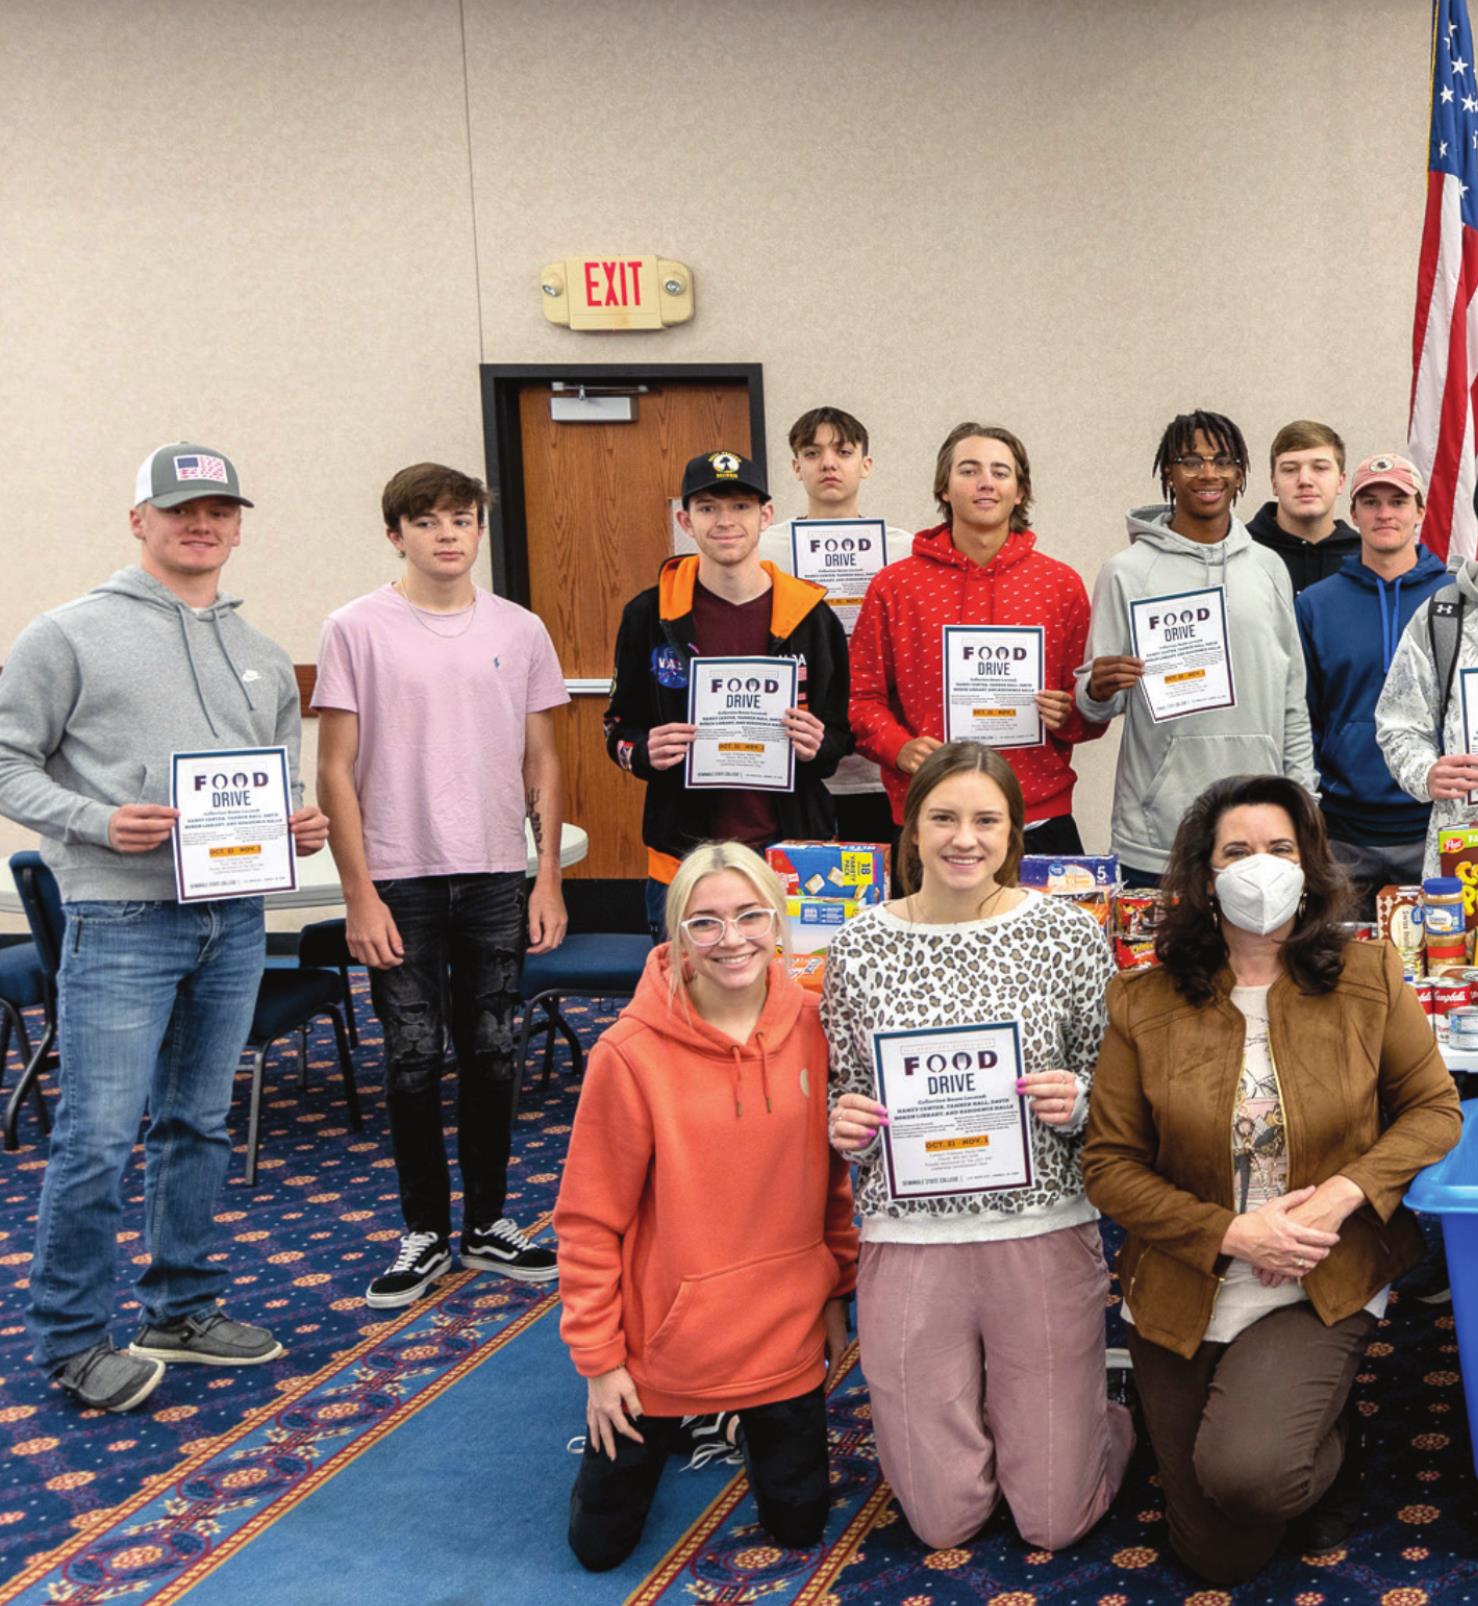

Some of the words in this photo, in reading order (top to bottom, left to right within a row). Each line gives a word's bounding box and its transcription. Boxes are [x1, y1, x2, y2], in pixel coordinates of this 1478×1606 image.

[584, 261, 643, 307] EXIT
[810, 538, 872, 552] FOOD
[825, 553, 856, 567] DRIVE
[1149, 608, 1210, 629] FOOD
[1164, 625, 1196, 642] DRIVE
[963, 646, 1027, 660] FOOD
[978, 662, 1011, 676] DRIVE
[711, 678, 779, 693] FOOD
[726, 694, 761, 708] DRIVE
[194, 772, 269, 792] FOOD
[212, 790, 251, 808] DRIVE
[1096, 866, 1106, 880] 5
[904, 1050, 998, 1076] FOOD
[928, 1072, 976, 1095] DRIVE
